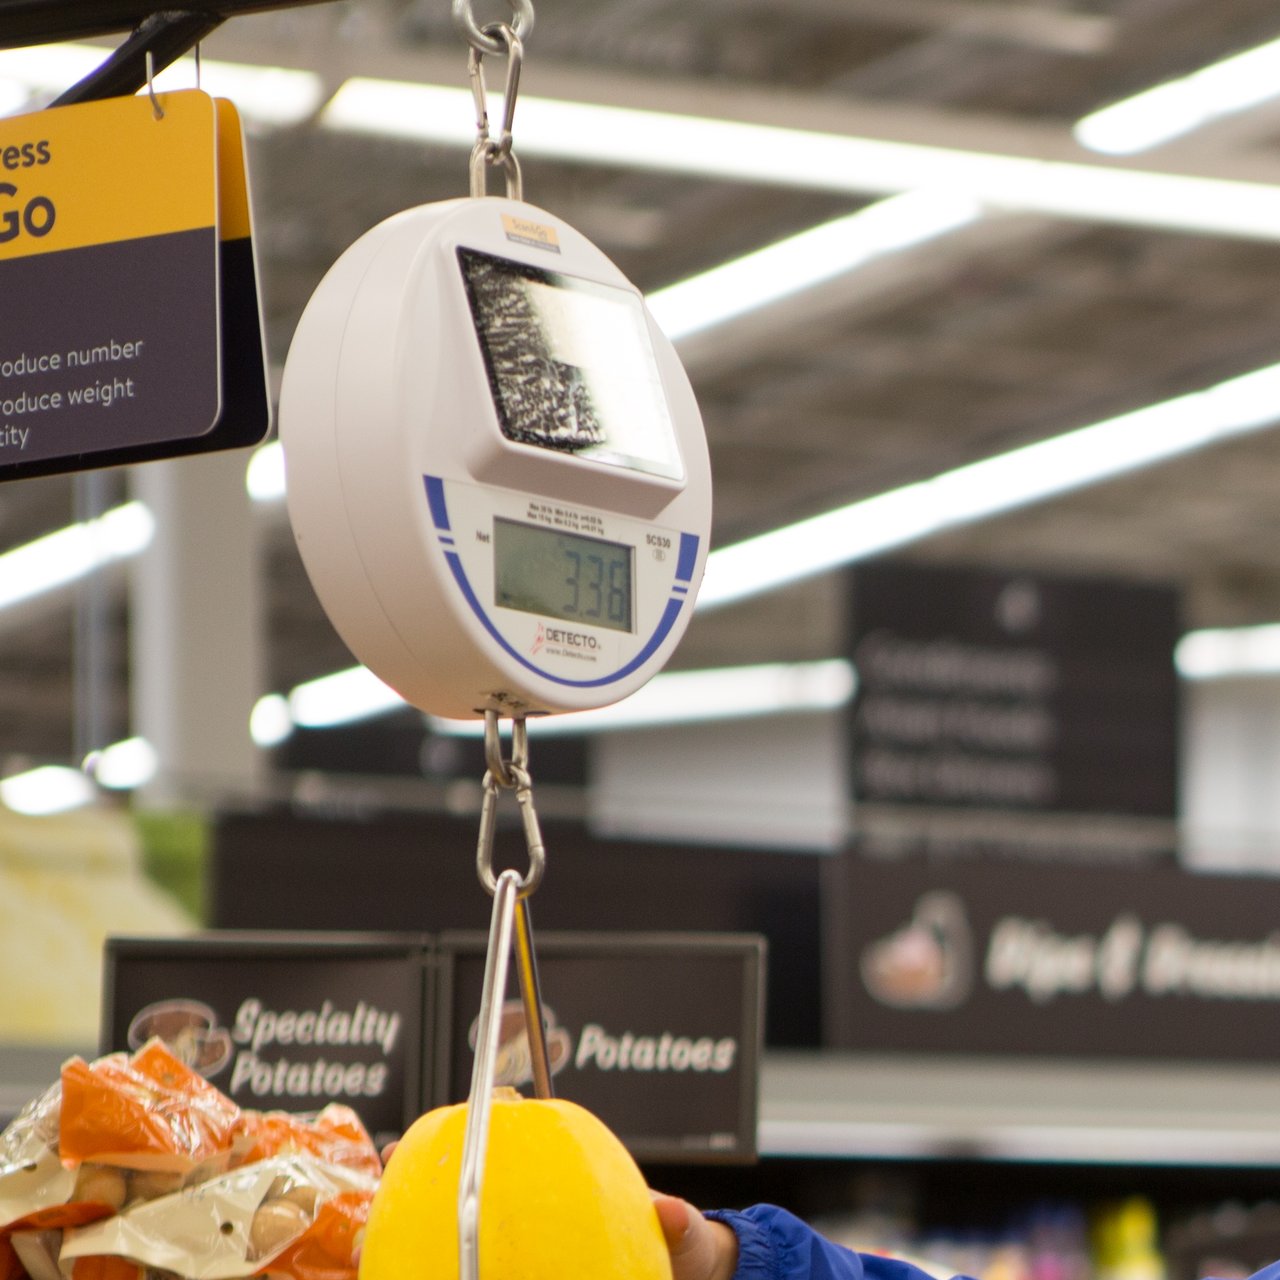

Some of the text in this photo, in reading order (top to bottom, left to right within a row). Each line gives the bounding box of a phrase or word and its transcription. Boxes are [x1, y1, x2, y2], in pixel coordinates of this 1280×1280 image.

[0, 140, 51, 170] ess
[0, 338, 144, 377] oduce number
[0, 377, 135, 416] oduce weight
[476, 530, 490, 544] Net
[646, 533, 671, 549] SCS30
[546, 628, 597, 649] DETECTO
[230, 998, 402, 1055] Specialty
[574, 1023, 738, 1073] Potatoes
[229, 1049, 390, 1098] Potatoes
